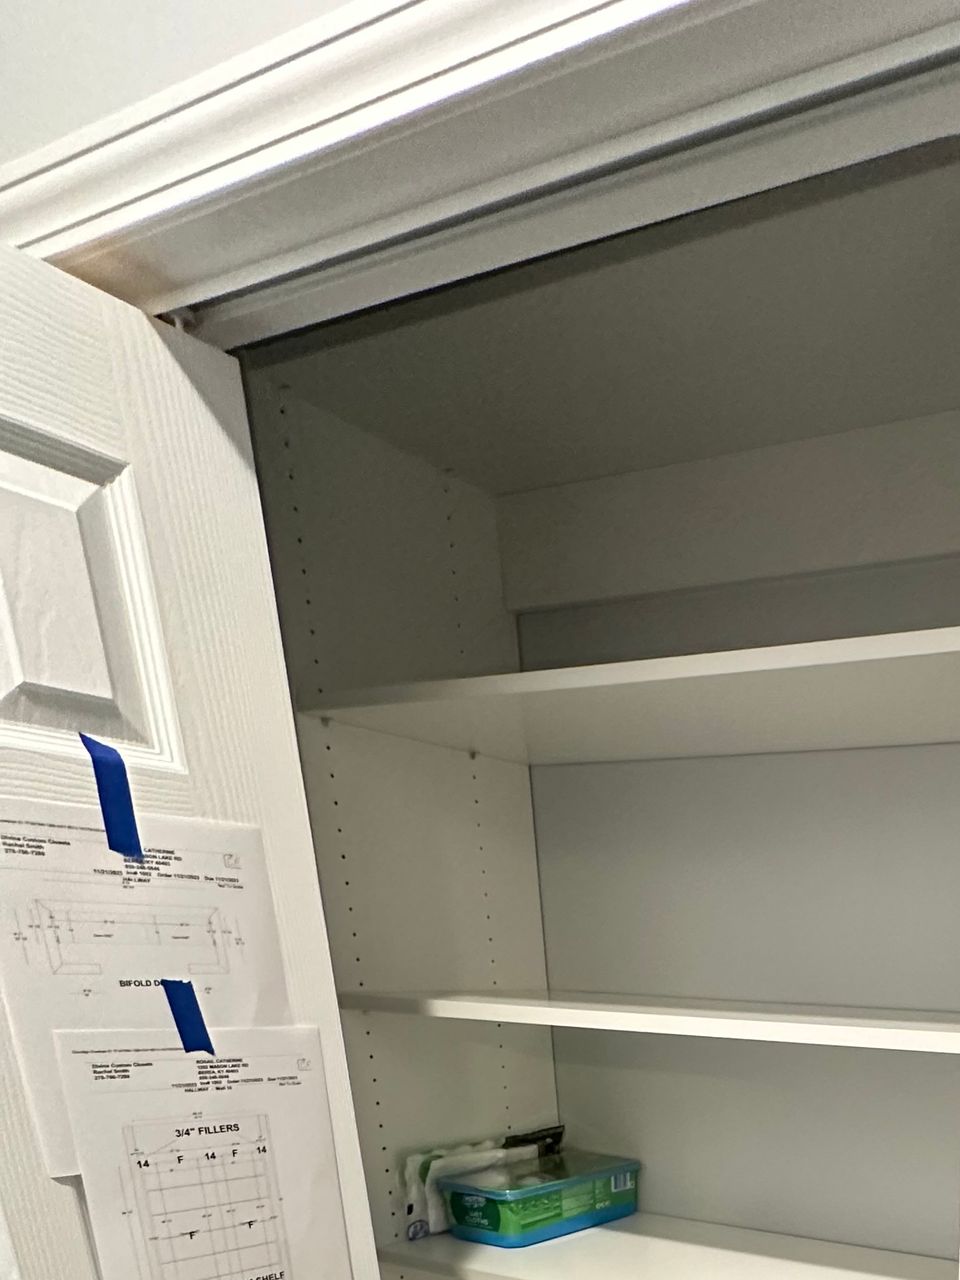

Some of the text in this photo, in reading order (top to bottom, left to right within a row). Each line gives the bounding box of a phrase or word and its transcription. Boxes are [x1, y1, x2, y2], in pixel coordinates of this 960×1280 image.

[119, 979, 152, 987] BIFOLD
[175, 1123, 240, 1138] 3/4" FILLERS
[137, 1145, 267, 1169] 14 F 14 F 14
[247, 1220, 255, 1229] F
[189, 1231, 196, 1240] F
